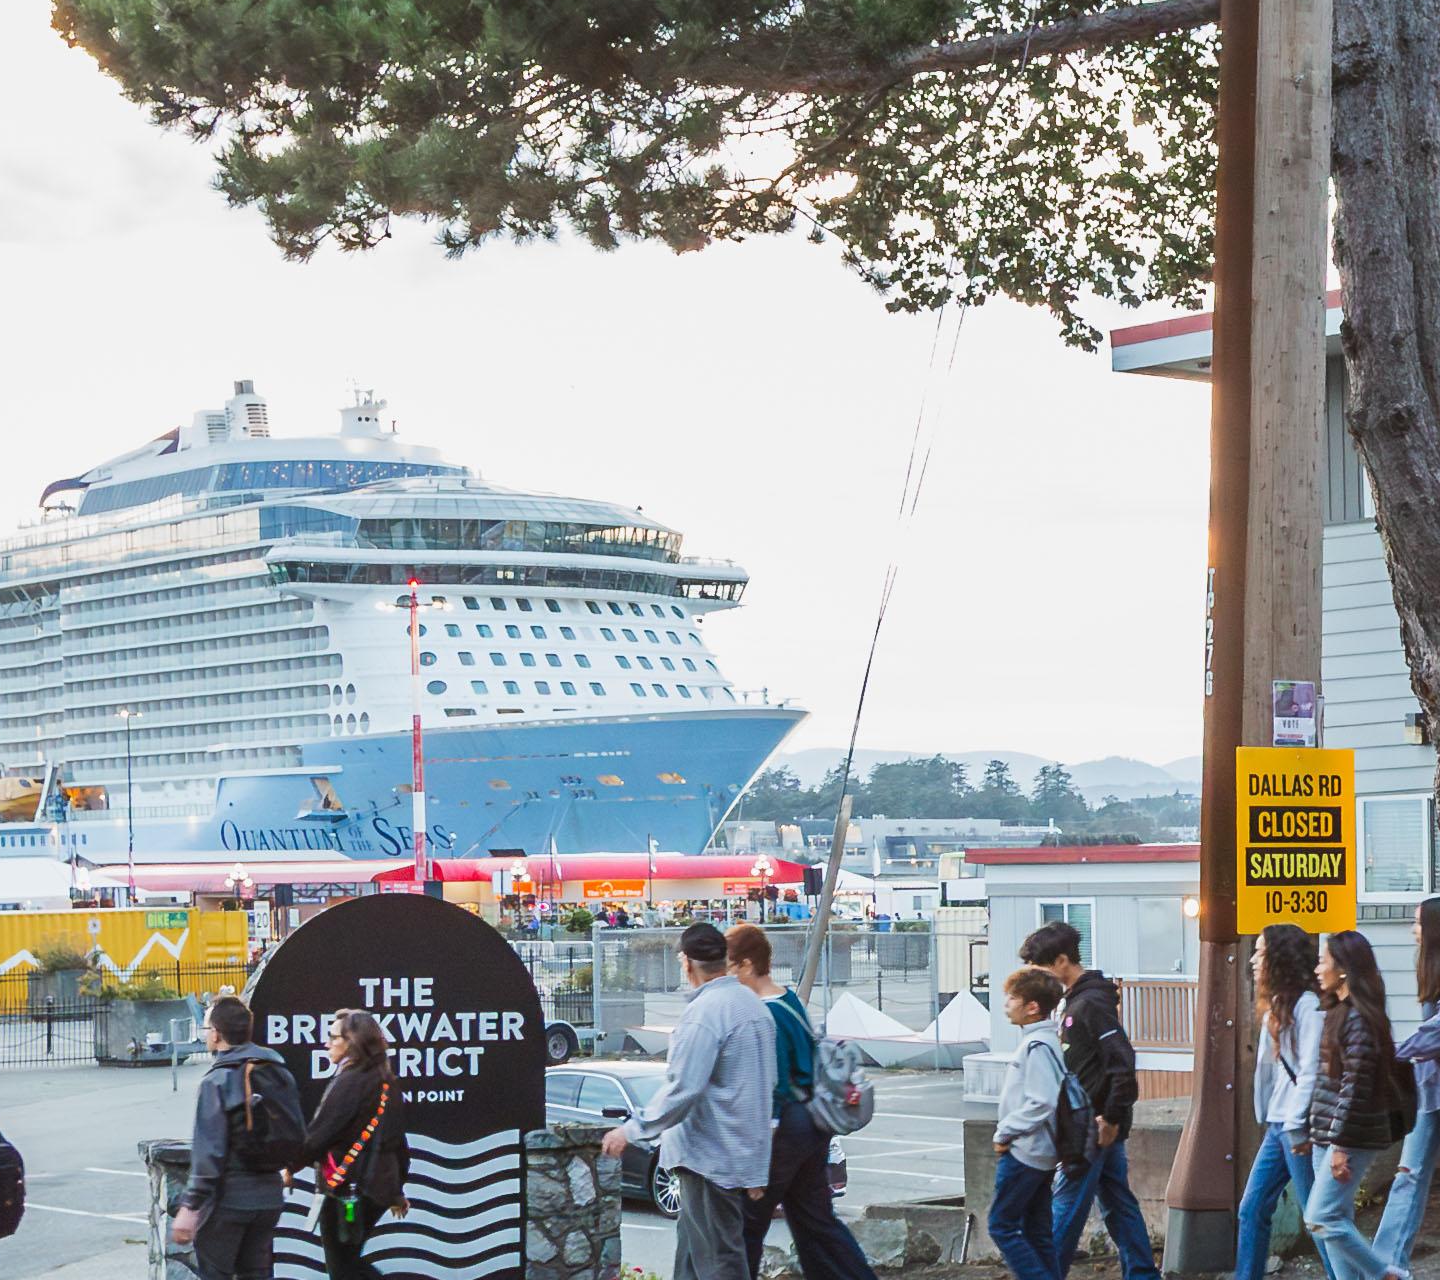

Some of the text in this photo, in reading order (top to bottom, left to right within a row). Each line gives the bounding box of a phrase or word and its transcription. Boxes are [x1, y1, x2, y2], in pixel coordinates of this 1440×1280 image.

[1248, 773, 1342, 797] DALLAS RD
[1258, 811, 1333, 838] CLOSED
[1250, 852, 1342, 879] SATURDAY
[1265, 890, 1328, 914] 10-3:30
[359, 977, 434, 1008] THE
[266, 1011, 525, 1045] BREKWATER
[311, 1046, 485, 1080] DTRICT
[417, 1089, 465, 1102] POINT
